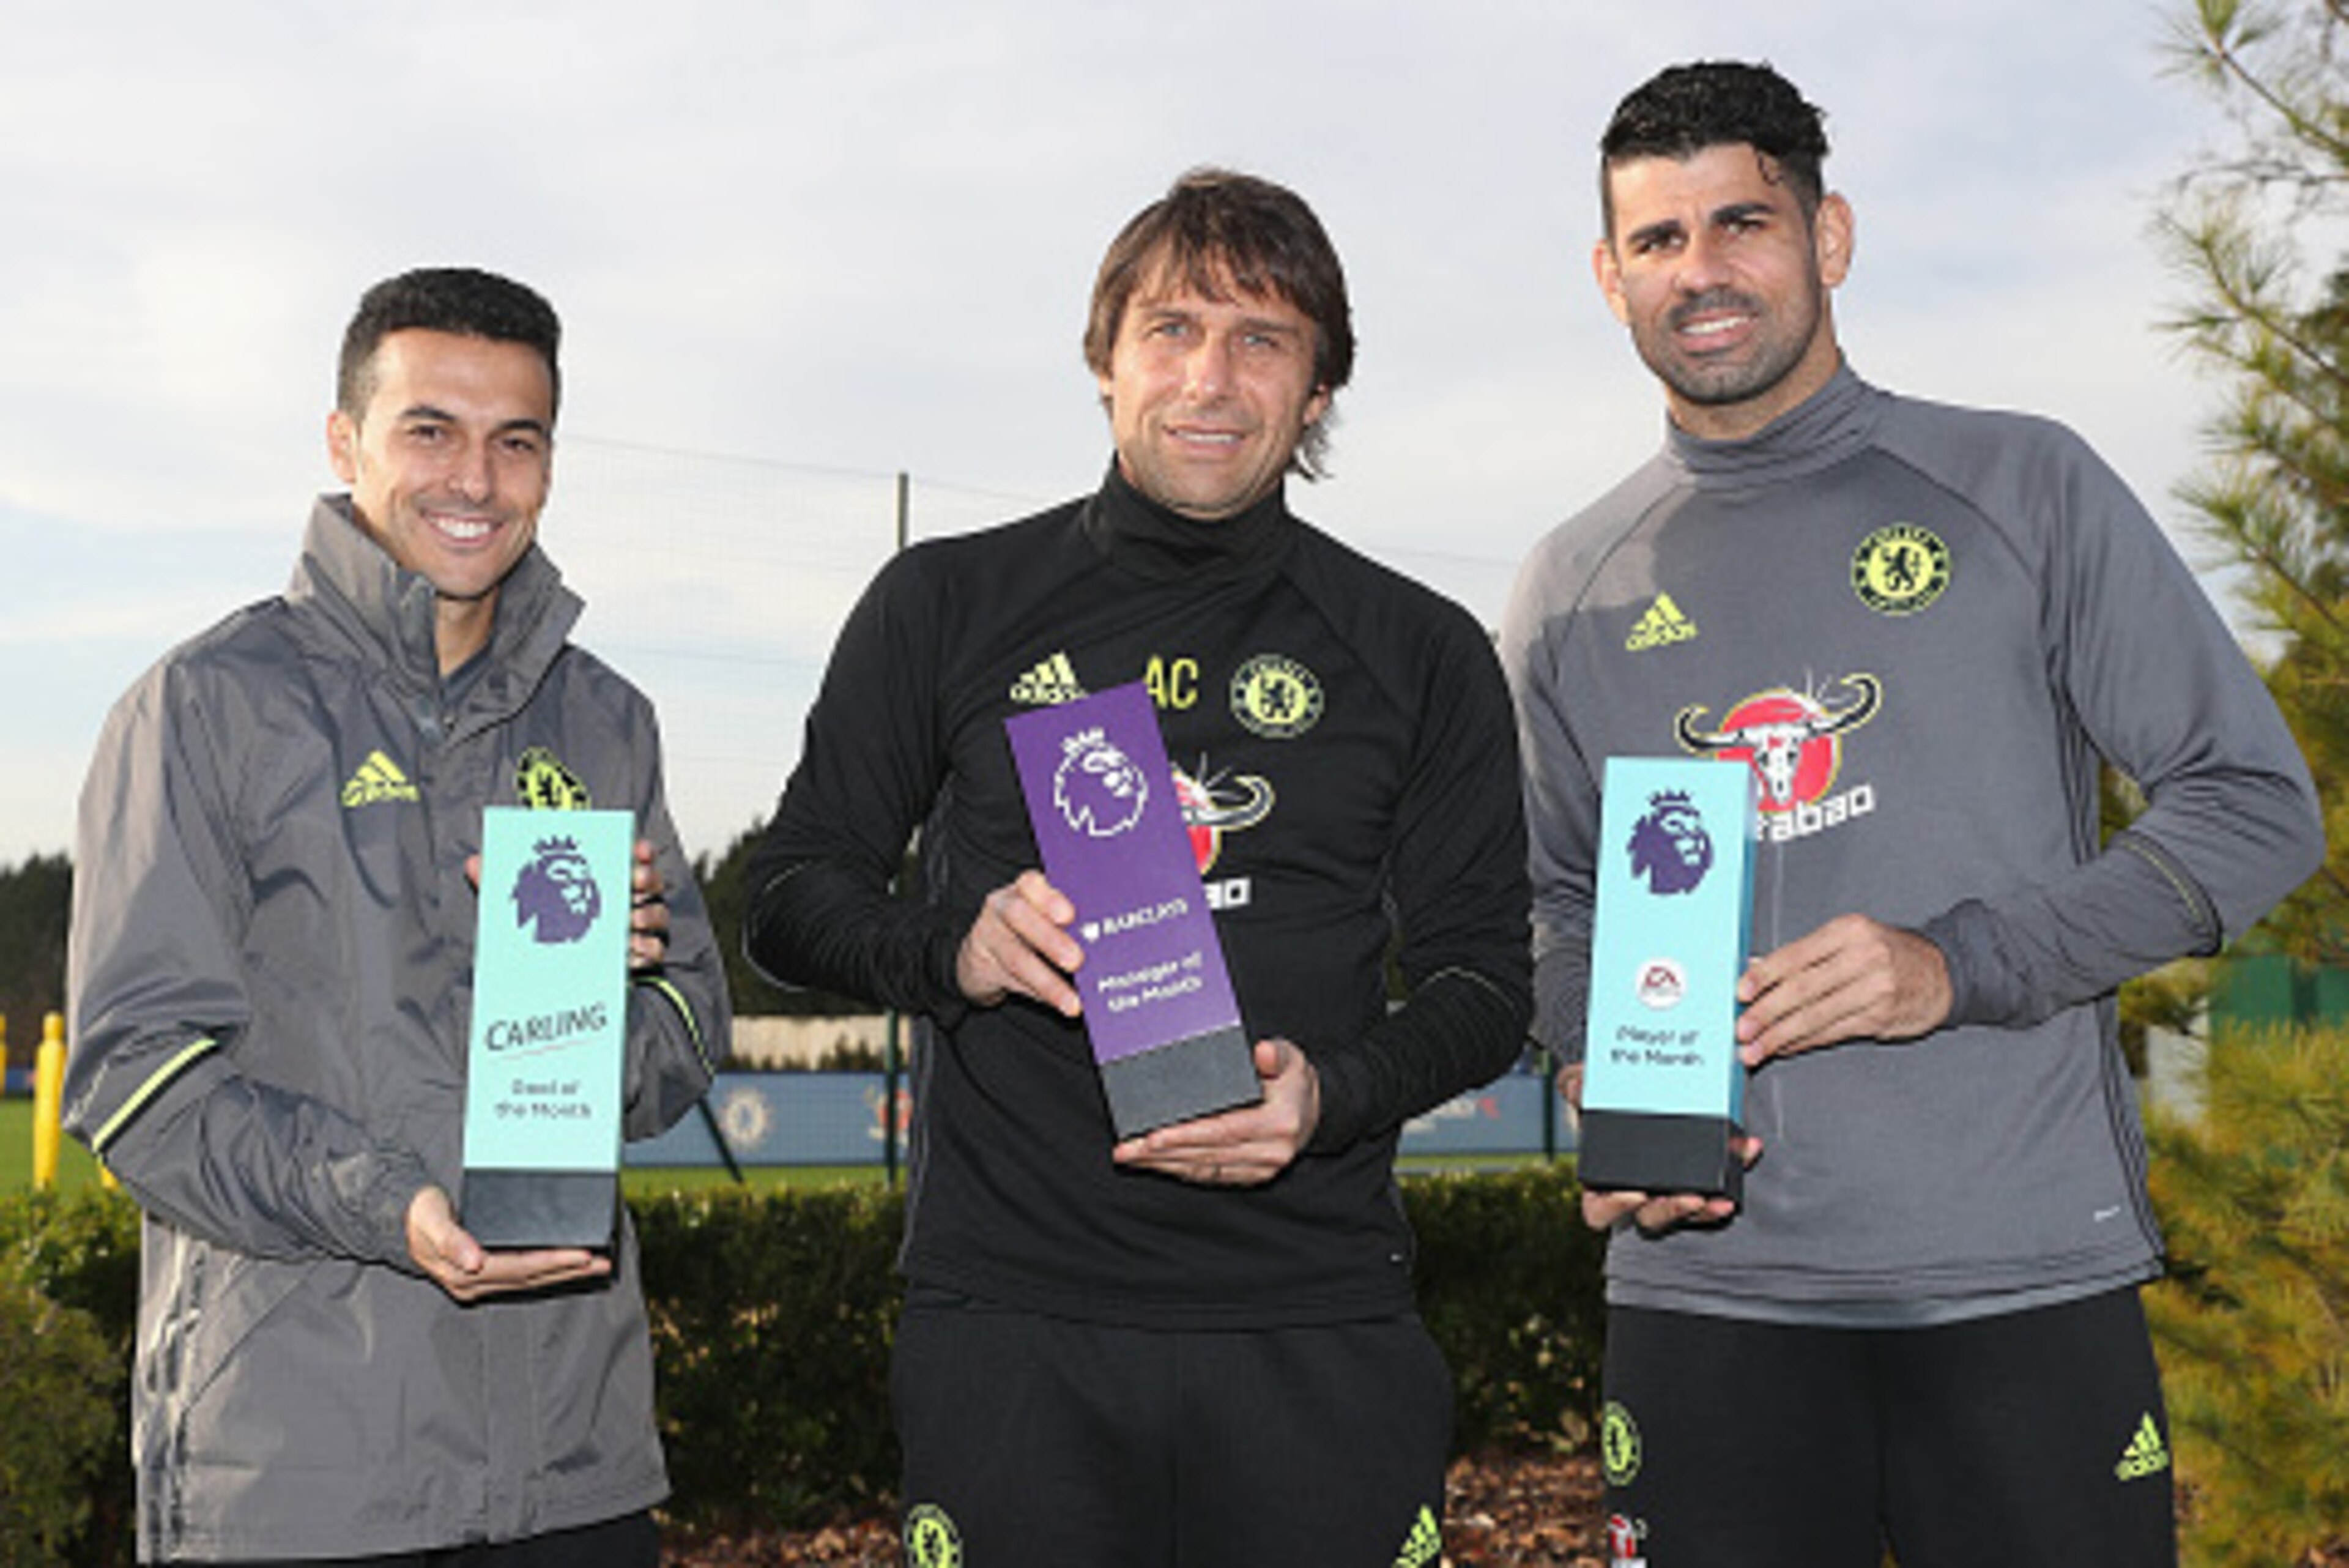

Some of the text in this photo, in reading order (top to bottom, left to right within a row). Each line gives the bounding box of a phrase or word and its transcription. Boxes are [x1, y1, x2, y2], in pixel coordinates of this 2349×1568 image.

[1142, 654, 1197, 708] AC
[1141, 975, 1203, 1001] Month
[485, 1001, 607, 1050] CARLING
[1645, 1049, 1705, 1066] Month
